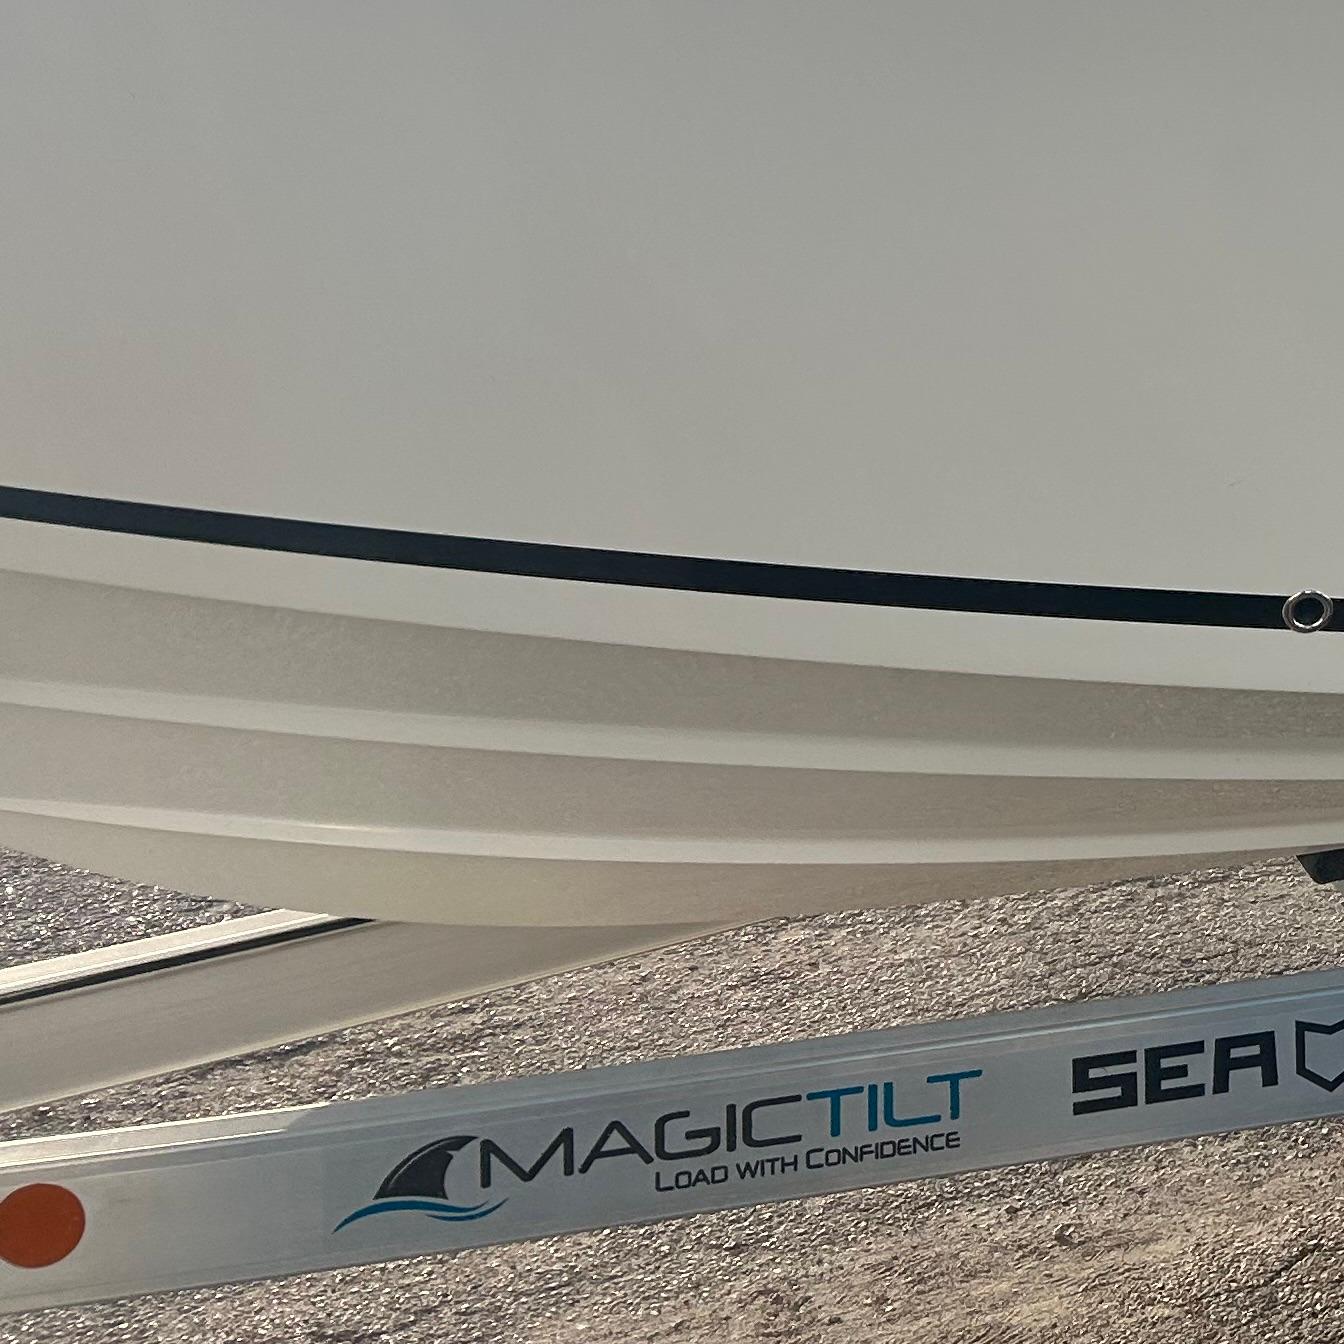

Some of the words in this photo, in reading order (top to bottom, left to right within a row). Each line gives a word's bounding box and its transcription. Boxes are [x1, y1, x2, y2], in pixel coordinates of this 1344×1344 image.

[1072, 1030, 1278, 1116] SEA
[480, 1069, 983, 1188] MAGICTILT
[655, 1165, 728, 1192] LOAD
[736, 1155, 798, 1180] WITH
[806, 1131, 961, 1170] CONFIDENCE
